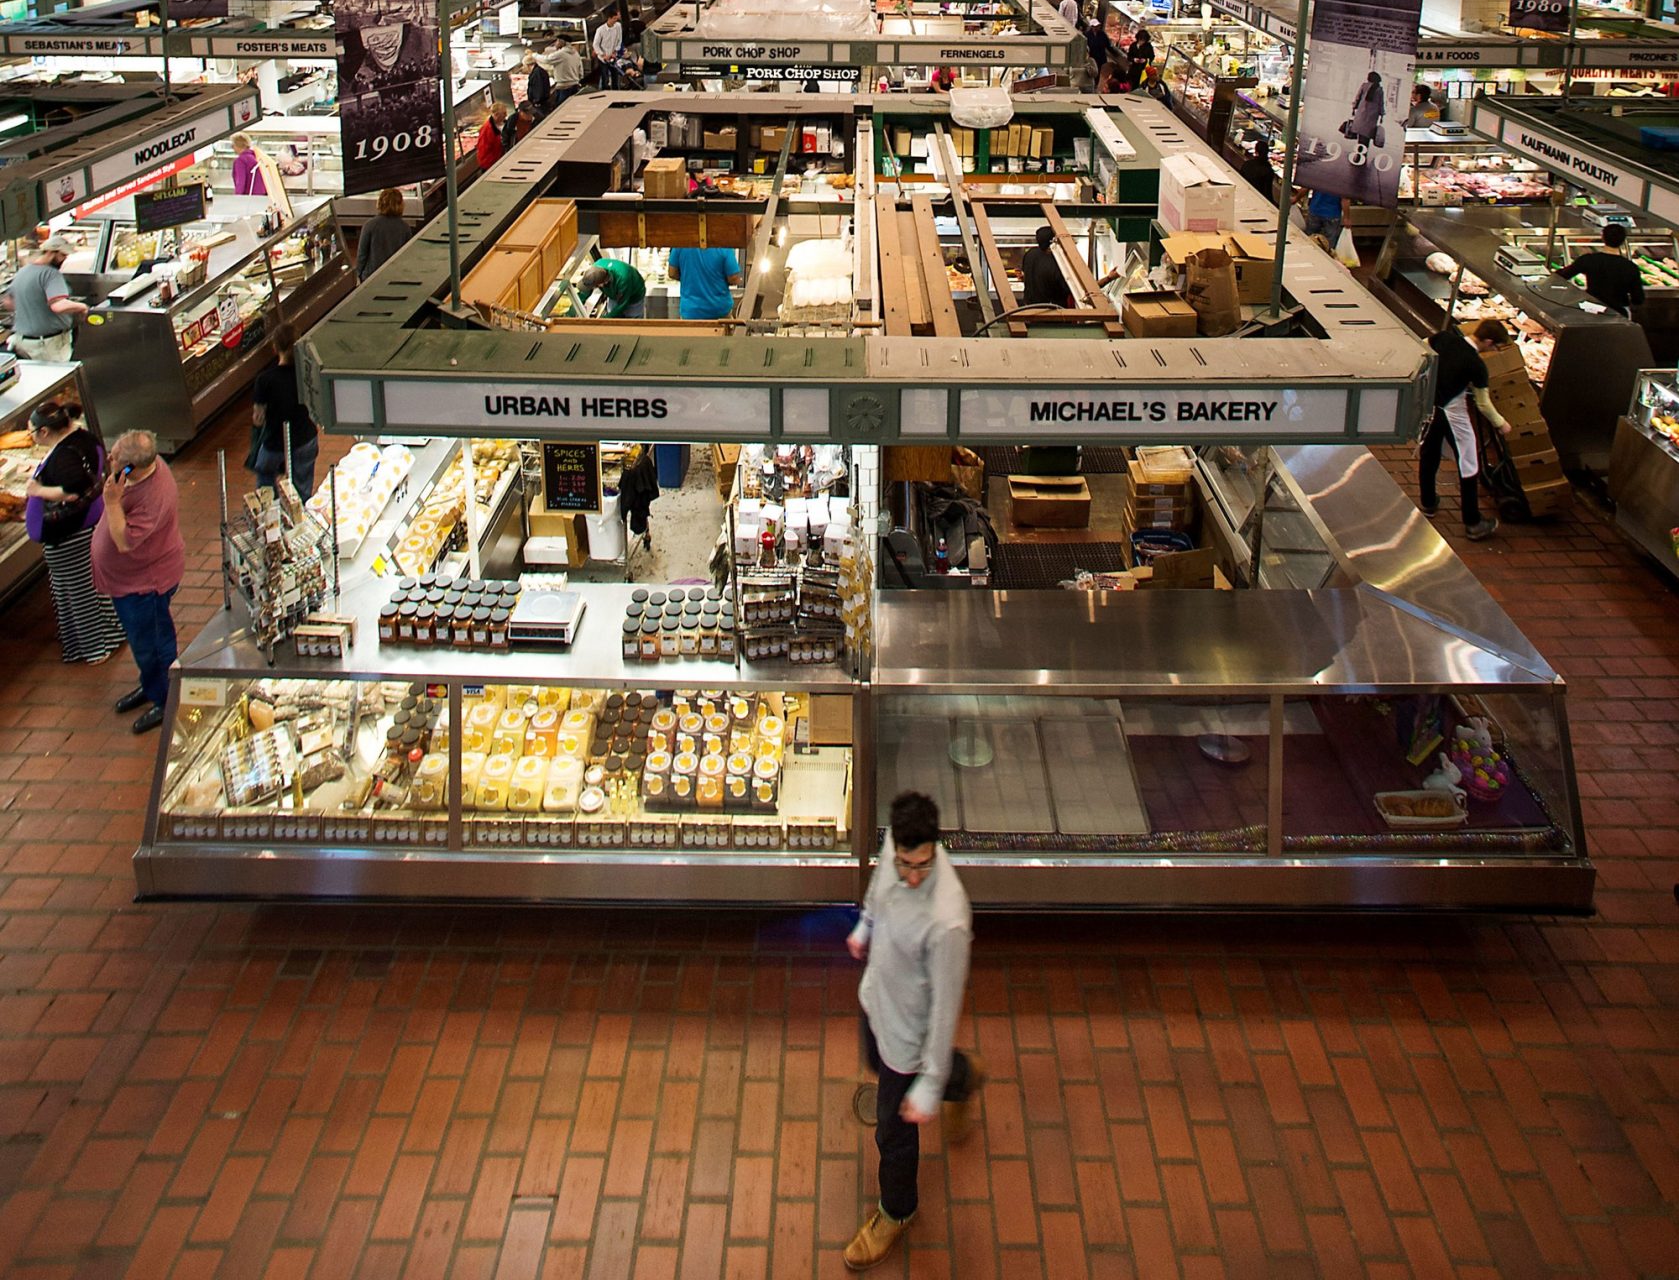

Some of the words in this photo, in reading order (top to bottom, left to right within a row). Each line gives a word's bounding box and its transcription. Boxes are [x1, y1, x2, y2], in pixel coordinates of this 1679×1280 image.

[1515, 0, 1562, 14] 1980
[25, 40, 94, 51] SEBASTIAN'S
[237, 42, 289, 52] FOSTER'S
[291, 42, 327, 52] MEATS
[702, 46, 733, 58] PORK
[735, 46, 765, 59] CHOP
[768, 46, 801, 59] SHOP
[940, 49, 1005, 59] FERNENGELS
[1416, 51, 1424, 60] M
[1426, 51, 1432, 60] &
[1434, 51, 1443, 60] M
[1446, 51, 1480, 60] FOODS
[1629, 52, 1678, 61] PINZONE'S
[745, 66, 784, 79] PORK
[784, 67, 822, 79] CHOP
[823, 68, 859, 80] SHOP
[1571, 68, 1616, 79] QUALITY
[1620, 68, 1656, 79] MEATS
[134, 127, 196, 165] NOODLECAT
[354, 124, 432, 162] 1908
[1305, 137, 1394, 172] 1980
[1520, 133, 1571, 166] KAUFMANN
[1572, 157, 1619, 187] POULTRY
[485, 395, 570, 417] URBAN
[581, 398, 668, 419] HERBS
[1030, 401, 1167, 422] MICHAEL'S
[1176, 402, 1278, 421] BAKERY
[553, 449, 586, 458] SPICES
[556, 463, 584, 472] HERBS
